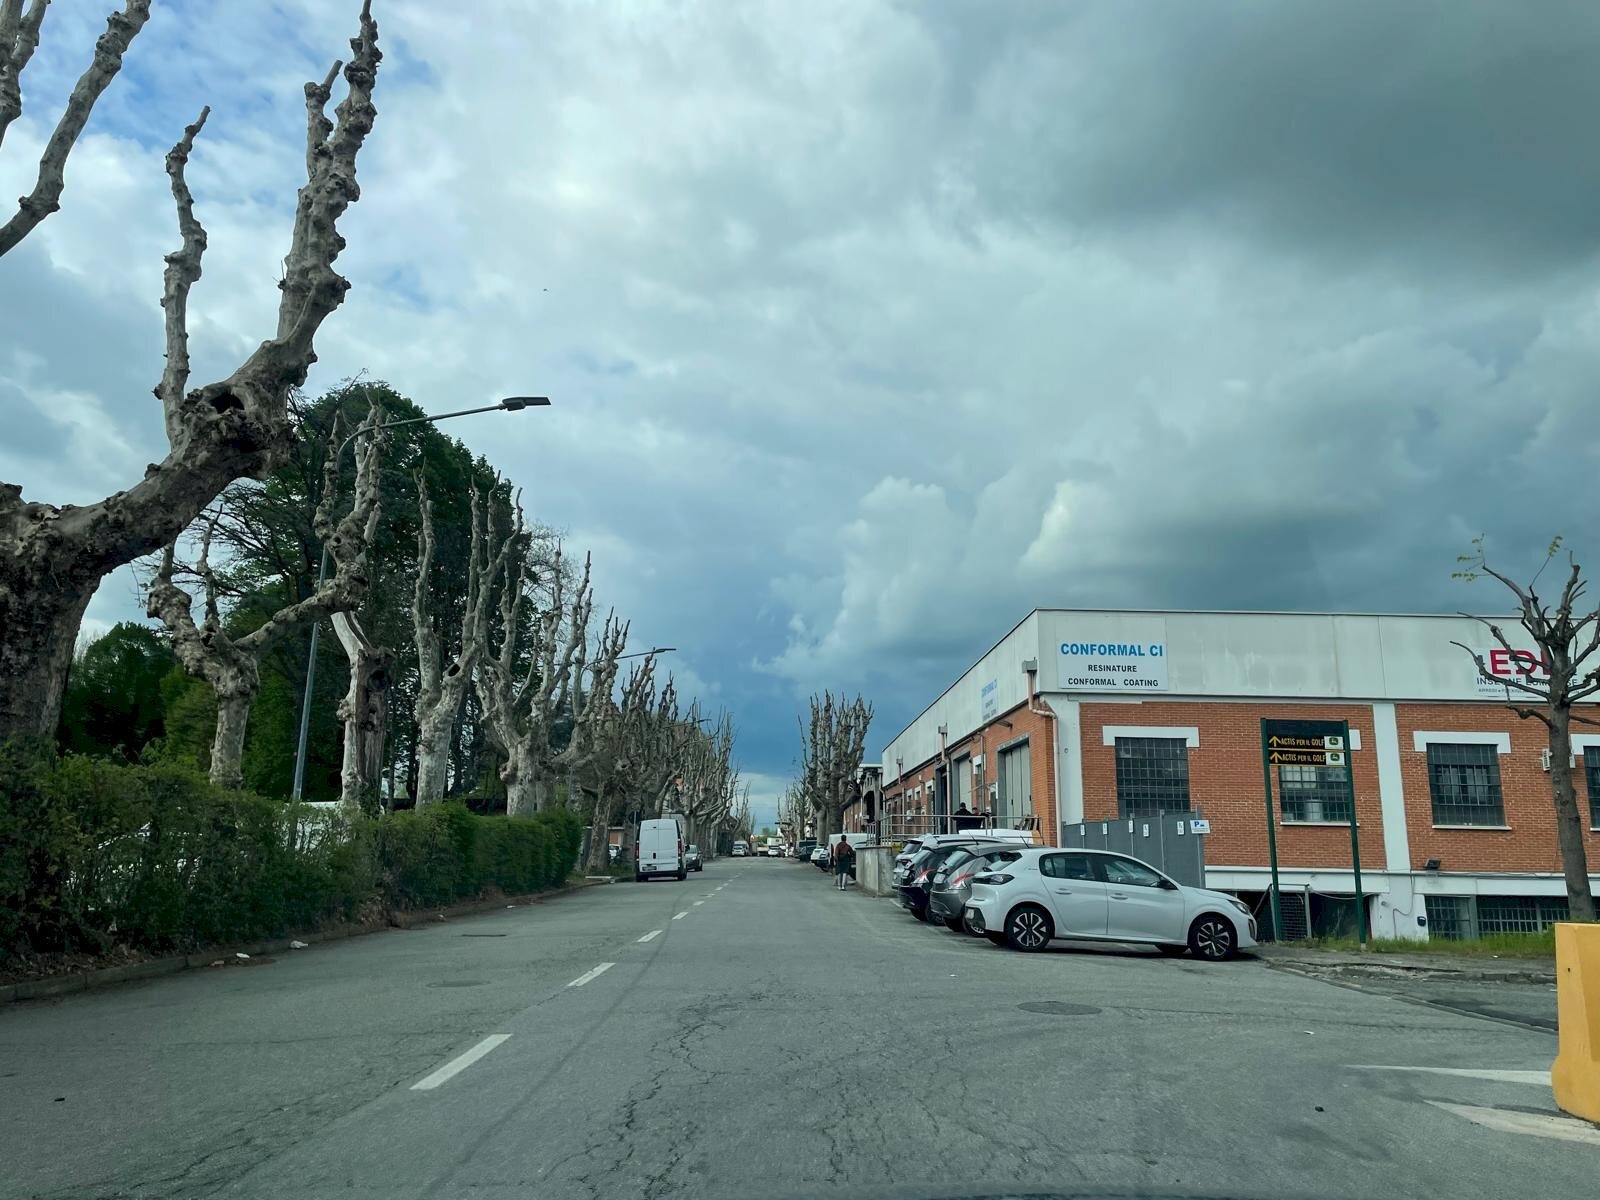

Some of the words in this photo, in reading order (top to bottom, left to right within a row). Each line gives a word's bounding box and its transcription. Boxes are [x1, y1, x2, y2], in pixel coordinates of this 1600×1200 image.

[1060, 643, 1145, 656] CONFORMAL
[1149, 645, 1163, 657] CI
[1087, 664, 1138, 672] RESINATURE
[1067, 678, 1117, 686] CONFORMAL
[1123, 679, 1159, 687] COATING
